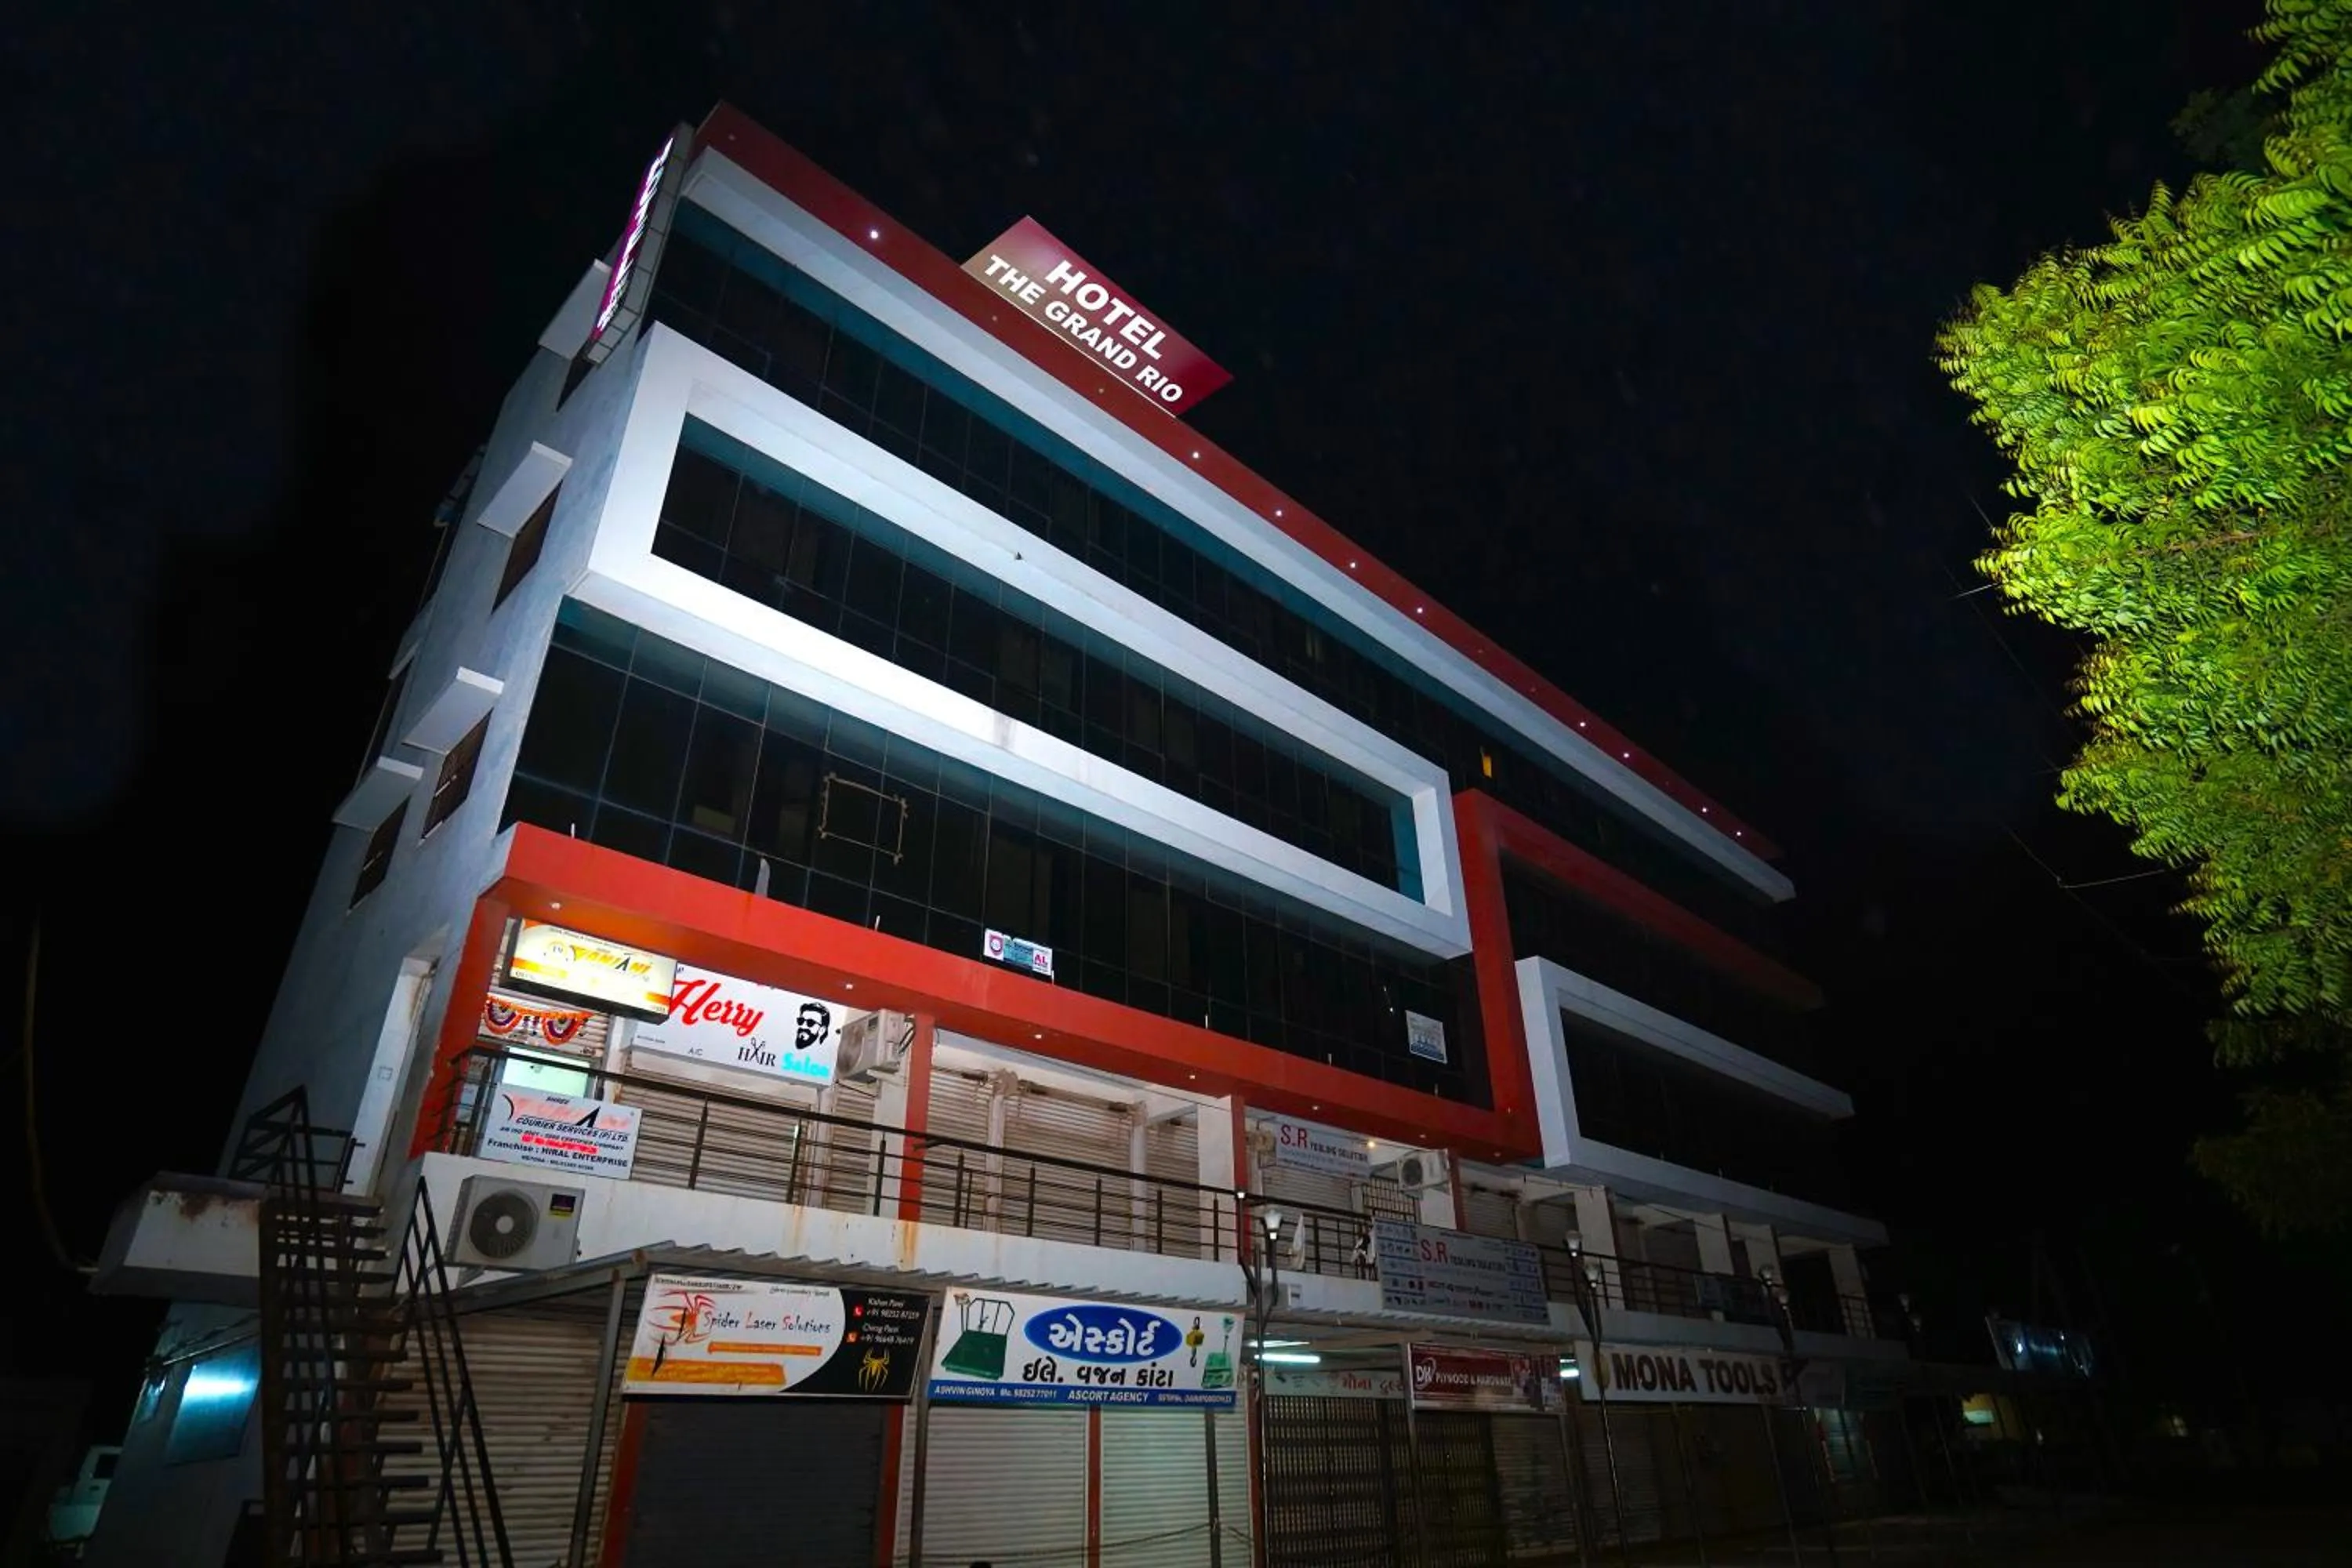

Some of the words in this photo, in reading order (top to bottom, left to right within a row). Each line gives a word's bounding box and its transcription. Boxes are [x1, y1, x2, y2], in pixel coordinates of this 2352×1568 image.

[1045, 260, 1167, 360] HOTEL
[984, 254, 1047, 305] THE
[1045, 300, 1138, 370] GRAND
[1135, 365, 1183, 402] RIO
[668, 979, 764, 1037] Herry
[782, 1052, 829, 1078] Salon
[516, 1117, 554, 1130] COURIER
[556, 1124, 598, 1138] SERVICES
[598, 1131, 610, 1141] (P)
[1280, 1124, 1307, 1149] S.R
[487, 1138, 533, 1153] Franchise
[541, 1148, 569, 1158] HIRAL
[572, 1152, 628, 1167] ENTERPRISE
[1421, 1240, 1449, 1264] S.R
[704, 1311, 740, 1332] Spider
[746, 1311, 777, 1330] Laser
[782, 1315, 832, 1334] Solutions
[1048, 1313, 1161, 1356] એસ્કોર્ટ
[1022, 1356, 1064, 1383] ઈલે.
[1076, 1366, 1126, 1385] વજન
[1136, 1361, 1174, 1387] કાંટા
[1611, 1353, 1697, 1392] MONA
[1697, 1359, 1777, 1395] TOOLS
[1067, 1390, 1108, 1401] ASCORT
[1109, 1392, 1149, 1403] AGENCY
